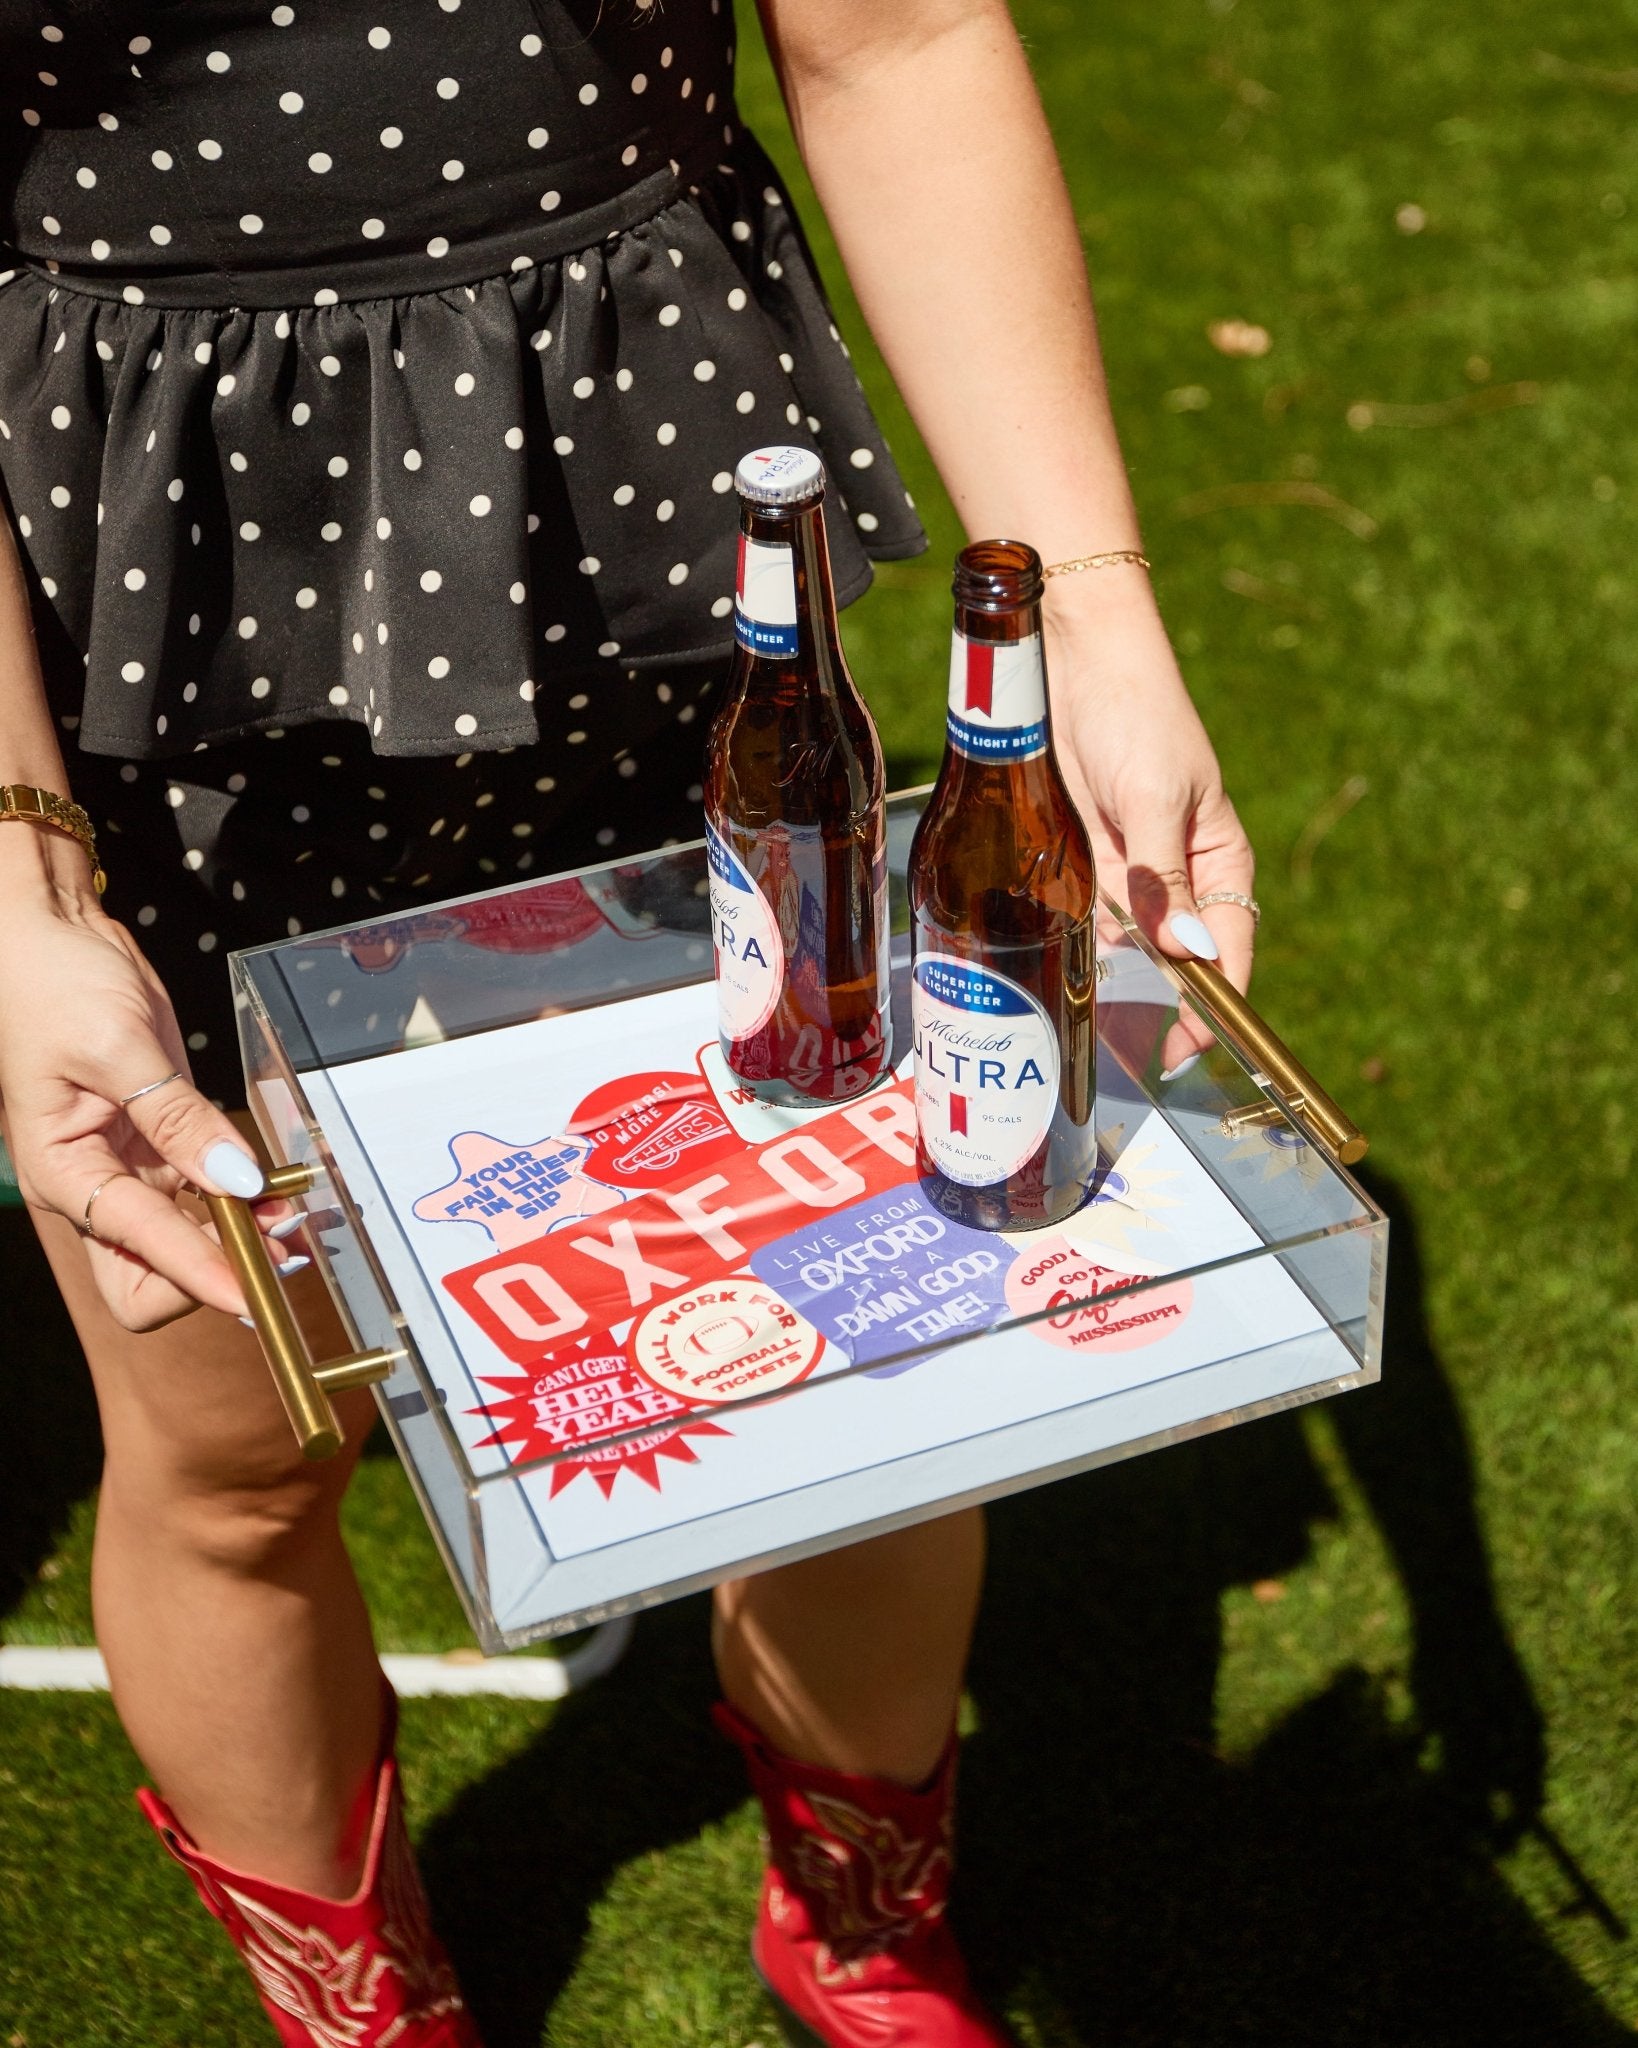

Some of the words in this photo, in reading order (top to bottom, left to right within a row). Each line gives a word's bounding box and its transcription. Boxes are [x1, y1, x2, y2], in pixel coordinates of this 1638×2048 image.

[764, 448, 802, 478] ULTRA
[756, 632, 783, 643] BEER
[973, 736, 1007, 748] LIGHT
[1013, 733, 1039, 747] BEER
[711, 852, 730, 876] BEER
[711, 905, 767, 968] TRA
[925, 976, 957, 999] LIGHT
[963, 993, 1001, 1007] BEER
[928, 966, 993, 993] SUPERIOR
[918, 1008, 1012, 1052] Michelob
[912, 1018, 1046, 1089] ULTRA
[610, 1081, 673, 1130] TEARS!
[615, 1107, 662, 1145] MORE
[982, 1114, 995, 1123] 95
[997, 1116, 1022, 1124] CALS
[632, 1116, 713, 1165] CHEERS
[444, 1184, 496, 1218] FAV
[497, 1146, 581, 1190] LIVES
[462, 1151, 537, 1187] YOUR
[476, 1196, 514, 1218] IN
[511, 1167, 573, 1202] THE
[513, 1191, 562, 1220] SIP
[472, 1092, 917, 1342] OXFOR
[773, 1234, 841, 1271] LIVE
[855, 1198, 922, 1234] FROM
[799, 1215, 946, 1291] OXFORD
[1021, 1252, 1068, 1286] GOOD
[833, 1286, 922, 1337] DAMN
[918, 1250, 999, 1296] GOOD
[845, 1265, 908, 1300] IT'S
[926, 1250, 944, 1264] A
[1059, 1270, 1088, 1285] GO
[660, 1290, 738, 1326] WORK
[748, 1293, 797, 1330] FOR
[895, 1291, 990, 1343] TIME!
[1067, 1304, 1182, 1346] MISSISSIPPI
[651, 1333, 689, 1381] WILL
[690, 1337, 802, 1387] FOOTBALL
[711, 1351, 802, 1393] TICKETS
[534, 1390, 685, 1445] YEAH
